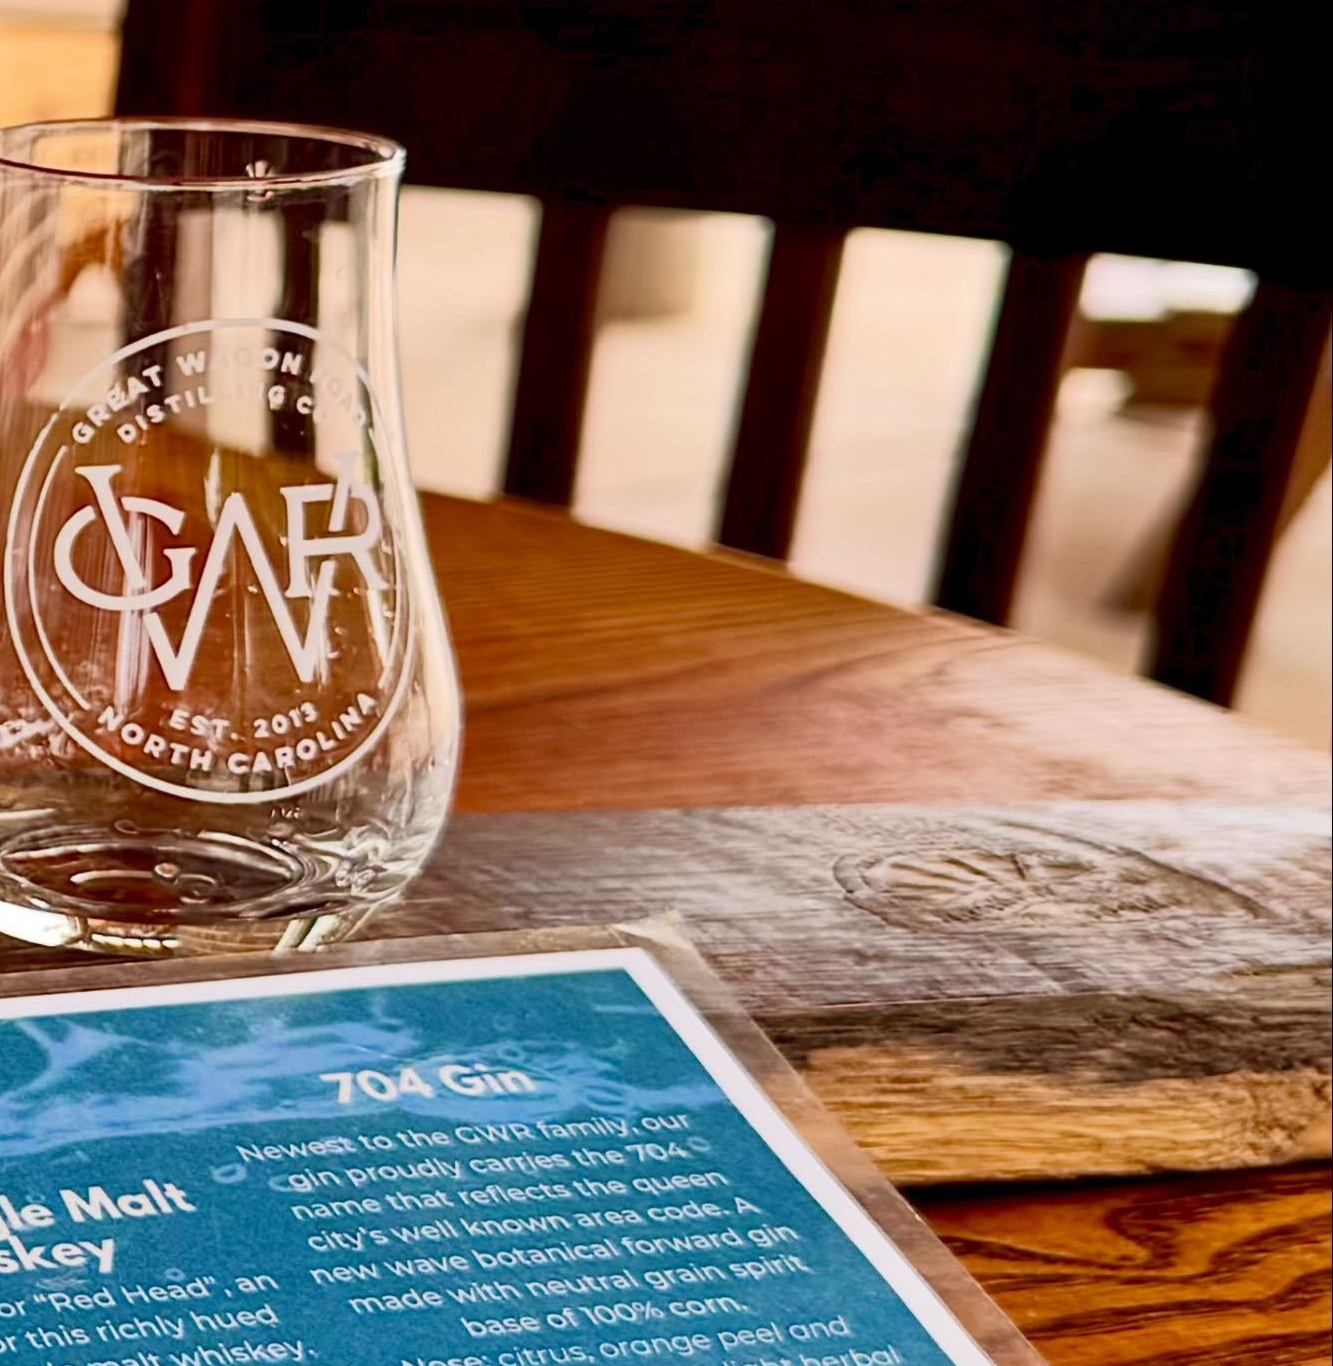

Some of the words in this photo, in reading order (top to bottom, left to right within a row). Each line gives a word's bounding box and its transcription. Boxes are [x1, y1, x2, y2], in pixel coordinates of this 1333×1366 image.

[72, 364, 163, 445] GREAT
[97, 705, 214, 772] NORTH
[227, 692, 378, 775] CAROLINA
[169, 707, 240, 741] EST.
[252, 701, 318, 739] 2013
[319, 1065, 434, 1105] 704
[437, 1061, 538, 1097] Gin
[58, 1176, 198, 1224] Malt
[290, 1196, 383, 1221] name
[384, 1188, 456, 1212] that
[456, 1181, 574, 1206] reflects
[571, 1176, 629, 1198] the
[631, 1170, 730, 1197] queen
[309, 1261, 380, 1285] new
[383, 1253, 471, 1277] wave
[470, 1236, 622, 1270] botanical
[619, 1225, 746, 1256] forward
[746, 1224, 801, 1249] gin
